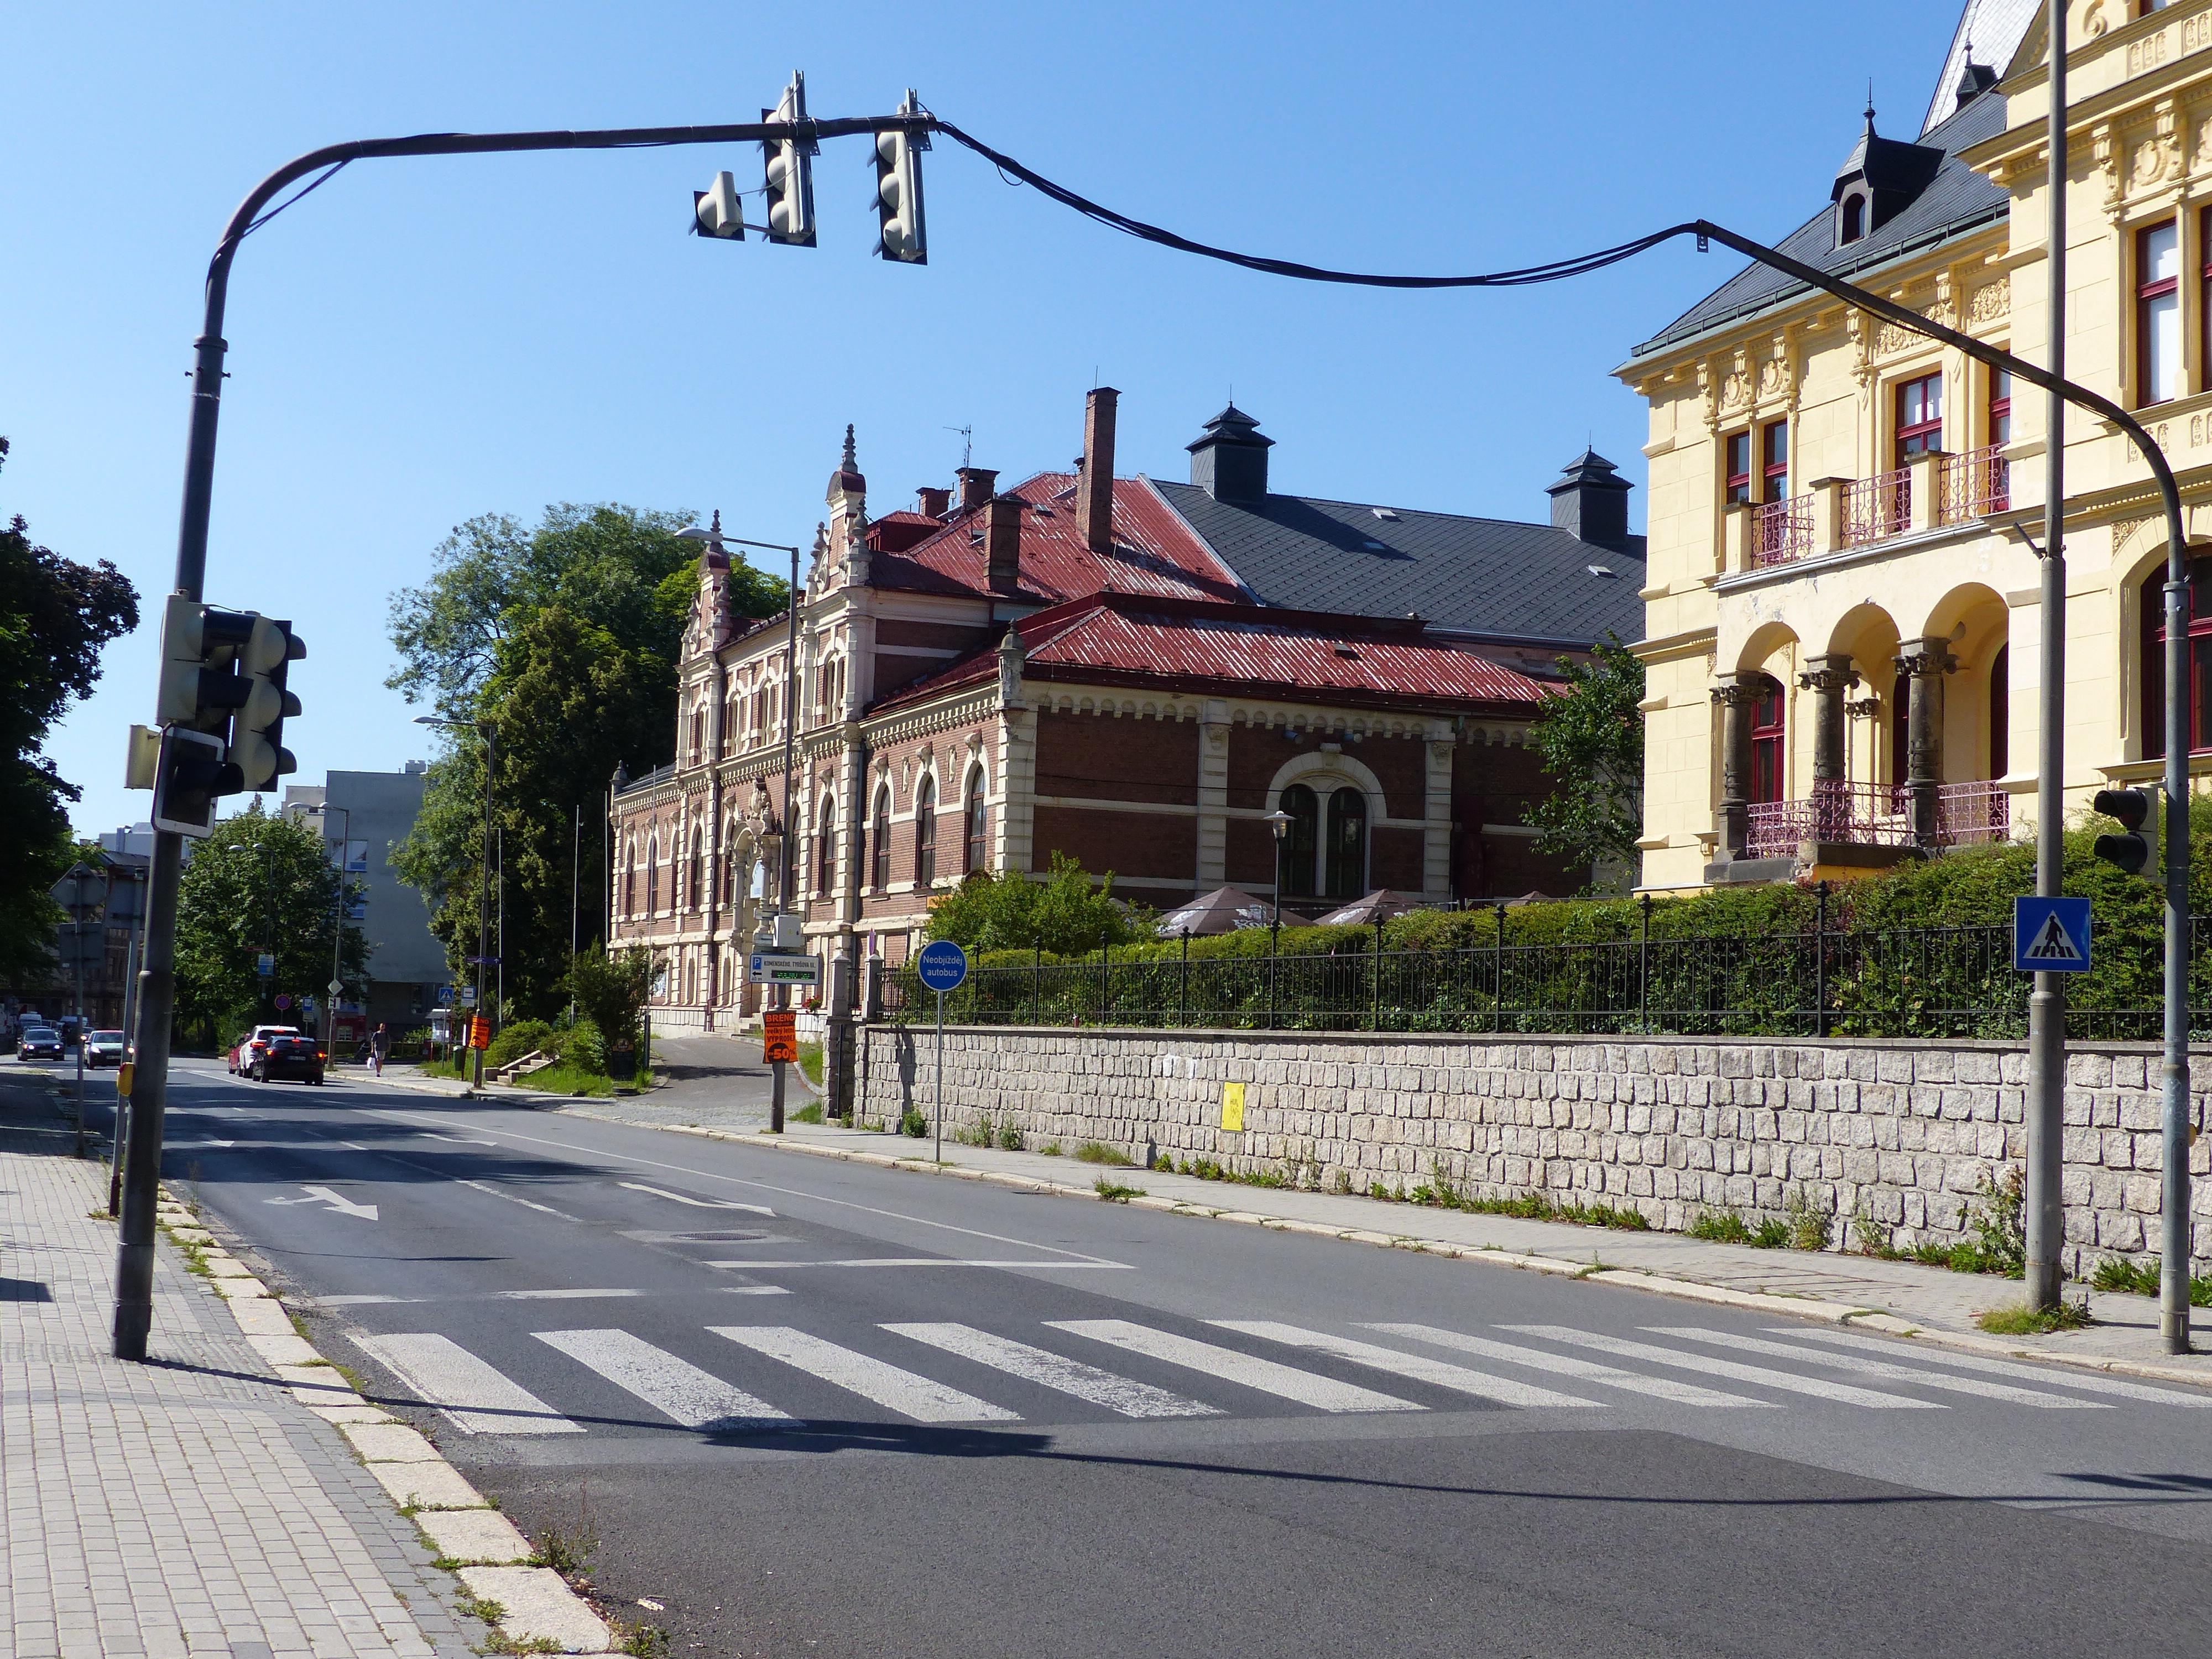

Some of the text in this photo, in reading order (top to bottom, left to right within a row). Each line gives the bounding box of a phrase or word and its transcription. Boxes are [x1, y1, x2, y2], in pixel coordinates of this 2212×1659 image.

[923, 956, 963, 966] Neobjížděj
[927, 968, 958, 977] autobus
[766, 1014, 795, 1022] BRENO
